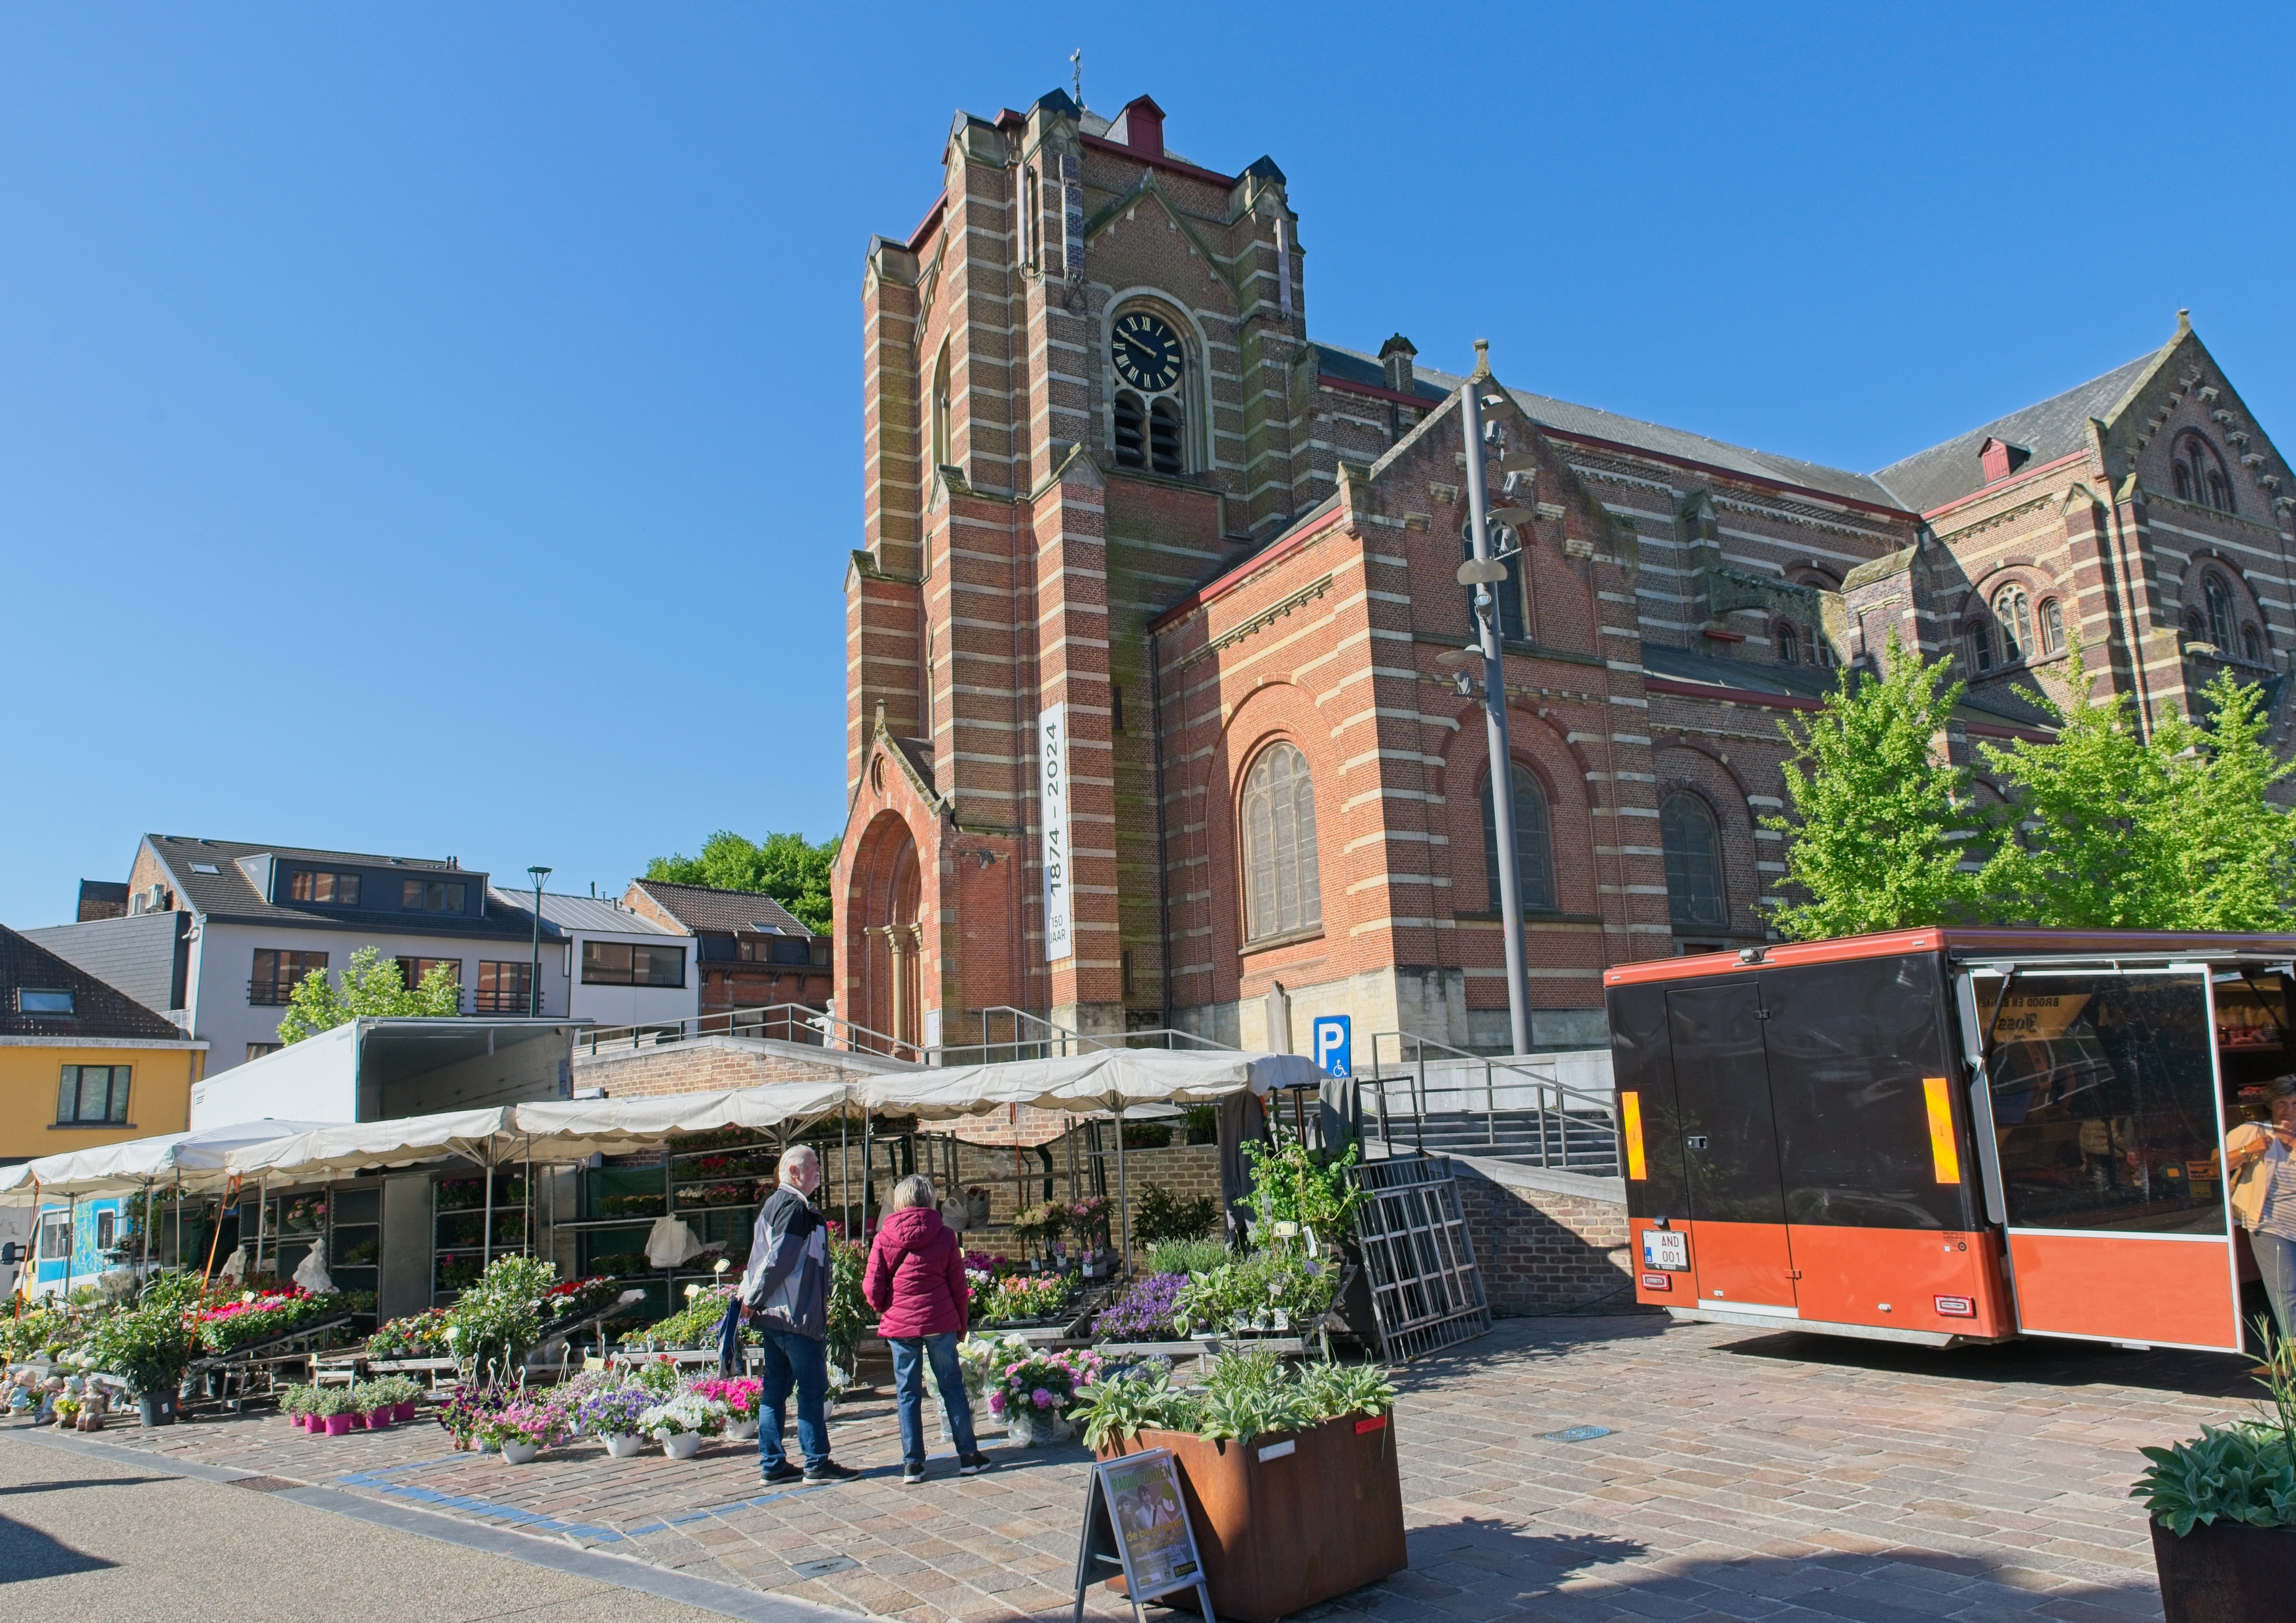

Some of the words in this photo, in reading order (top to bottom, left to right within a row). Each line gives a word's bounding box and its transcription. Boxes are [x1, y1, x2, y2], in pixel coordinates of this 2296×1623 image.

[1126, 317, 1139, 332] XI
[1141, 316, 1151, 331] XII
[1164, 340, 1175, 348] II
[1167, 354, 1179, 364] III
[1046, 722, 1058, 797] 2024
[1049, 828, 1061, 898] 1874
[1051, 915, 1063, 928] 150
[1049, 928, 1066, 944] JAAR
[1319, 1023, 1344, 1068] P
[1662, 1235, 1679, 1247] AND
[1662, 1250, 1679, 1263] 001
[1111, 1472, 1139, 1493] RADIO
[1139, 1463, 1173, 1485] ZONIËN
[1126, 1531, 1138, 1542] de
[1138, 1518, 1185, 1537] beginjaren
[1135, 1553, 1152, 1562] Dinsdag
